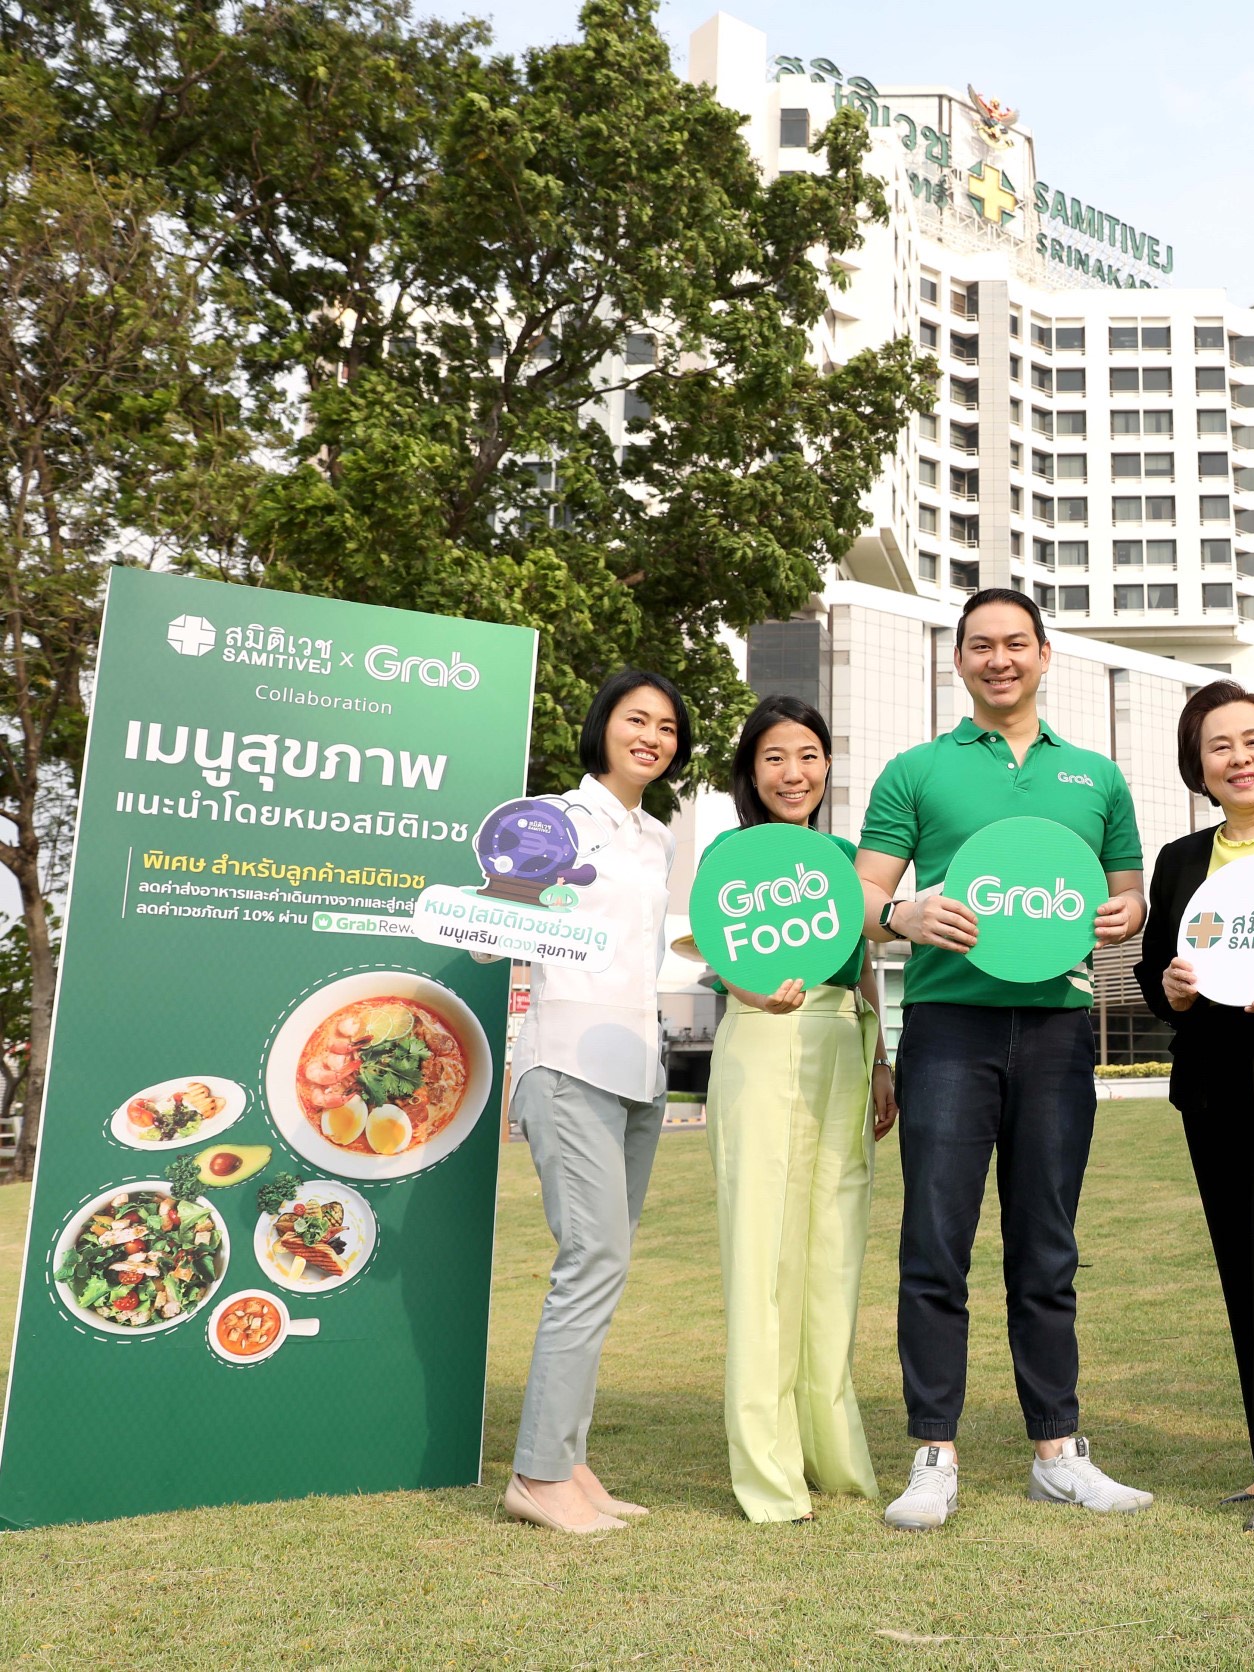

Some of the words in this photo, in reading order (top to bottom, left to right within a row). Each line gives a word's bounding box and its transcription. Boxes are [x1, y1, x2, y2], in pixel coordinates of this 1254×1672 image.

[1033, 181, 1173, 274] SAMITIVEJ
[222, 649, 332, 675] SAMITIVEJ
[225, 623, 333, 659] สมิติเวช
[364, 644, 480, 691] Grab
[255, 684, 392, 715] Collaboration
[125, 719, 447, 792] เมนูสุขภาพ
[1057, 771, 1094, 787] Grab
[116, 790, 469, 842] แนะนำโดยหมอสมิติเวช
[143, 850, 206, 873] พิเศษ
[211, 854, 425, 889] สำหรับลูกค้าสมิติเวช
[718, 863, 829, 918] Grab
[136, 902, 239, 921] ลดค่าเวชภัณฑ์
[242, 909, 275, 923] 10%
[279, 910, 308, 925] ผ่าน
[336, 917, 415, 934] GrabRew
[967, 875, 1085, 921] Grab
[722, 898, 840, 962] Food
